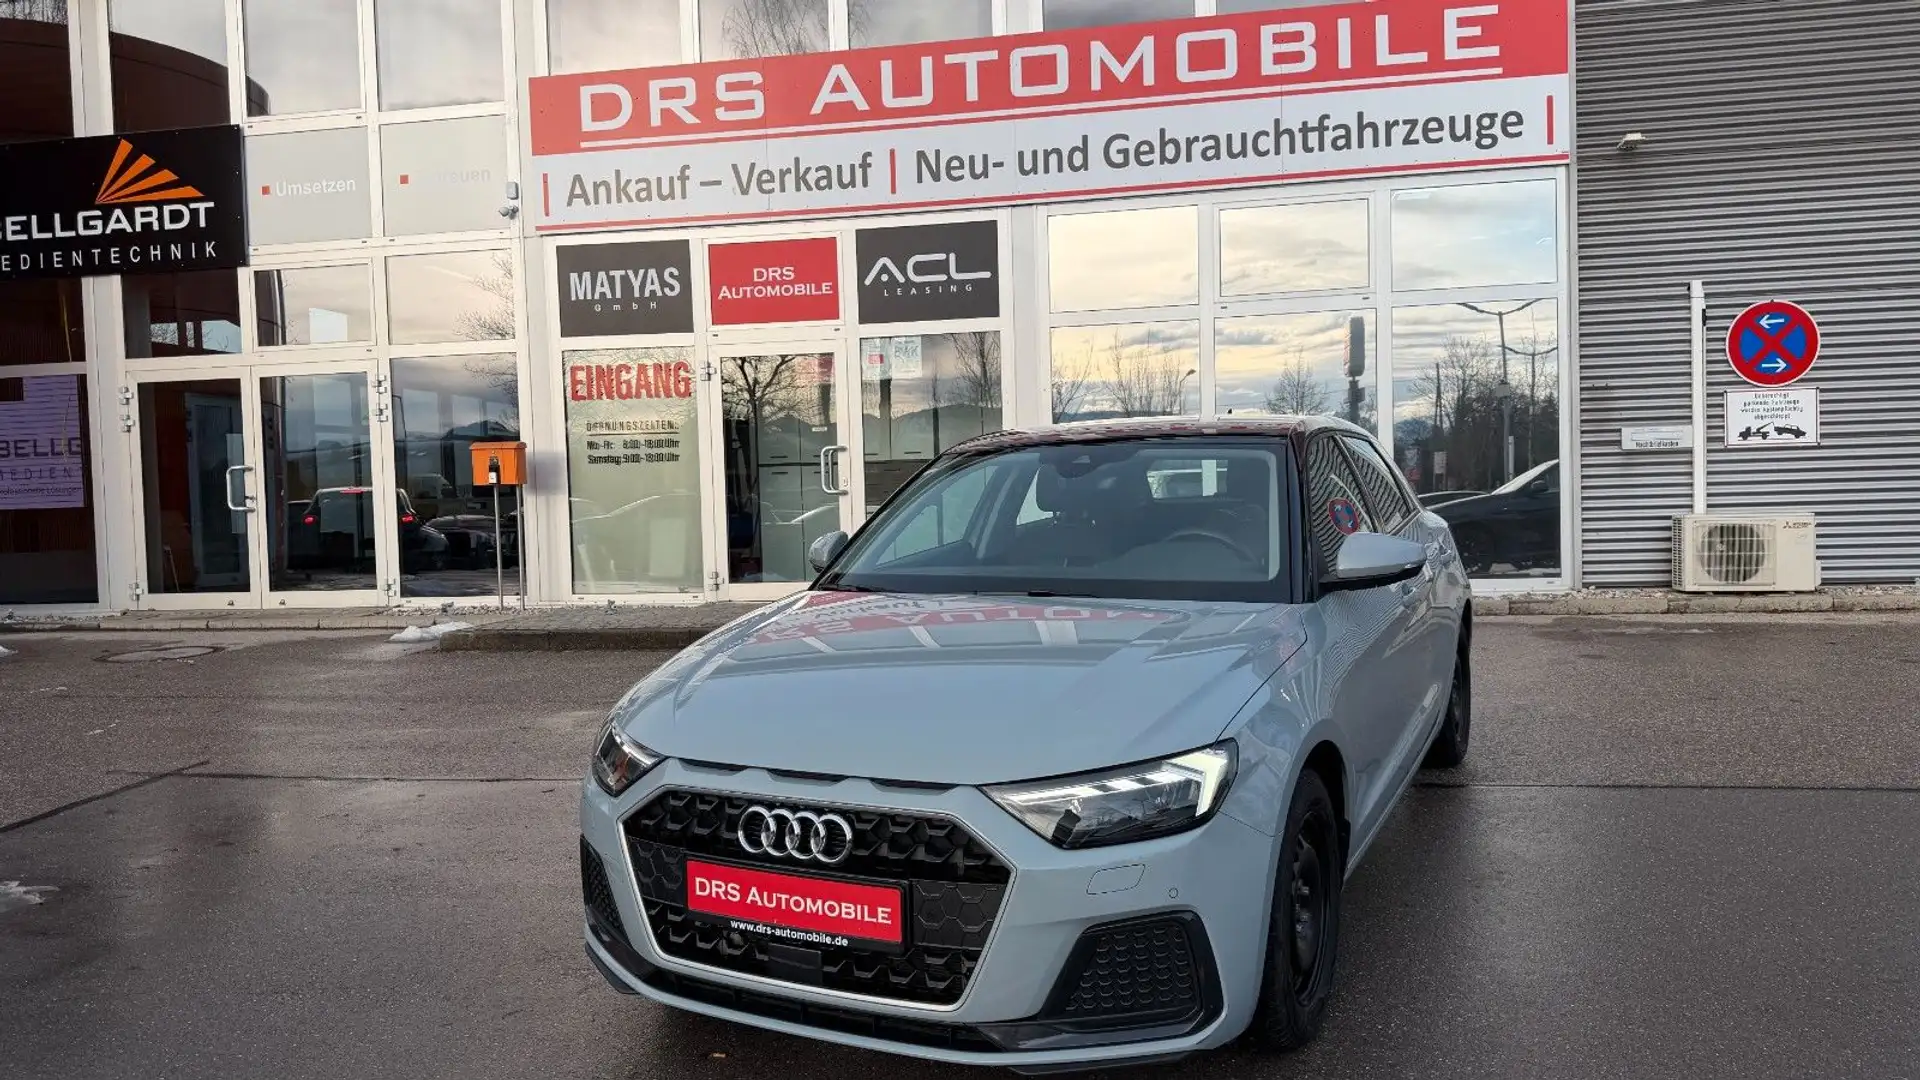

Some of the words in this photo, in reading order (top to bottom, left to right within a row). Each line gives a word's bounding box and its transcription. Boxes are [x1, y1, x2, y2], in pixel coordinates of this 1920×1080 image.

[580, 71, 765, 132] DRS
[810, 4, 1500, 115] AUTOMOBILE
[916, 147, 1005, 184] Neu-
[1017, 135, 1089, 177] und
[1103, 108, 1525, 169] Gebrauchtfahrzeuge
[276, 178, 357, 197] Umsetzen
[566, 164, 690, 207] Ankauf
[731, 151, 872, 196] Verkauf
[0, 202, 215, 241] ELLGARDT
[569, 266, 681, 301] MATYAS
[753, 266, 795, 282] DRS
[864, 252, 992, 286] ACL
[718, 282, 833, 300] AUTOMOBILE
[884, 284, 973, 297] LEASING
[569, 361, 692, 402] EINGANG
[694, 877, 741, 902] DRS
[746, 887, 892, 925] AUTOMOBILE
[730, 919, 849, 947] www.drs-automobile.de
